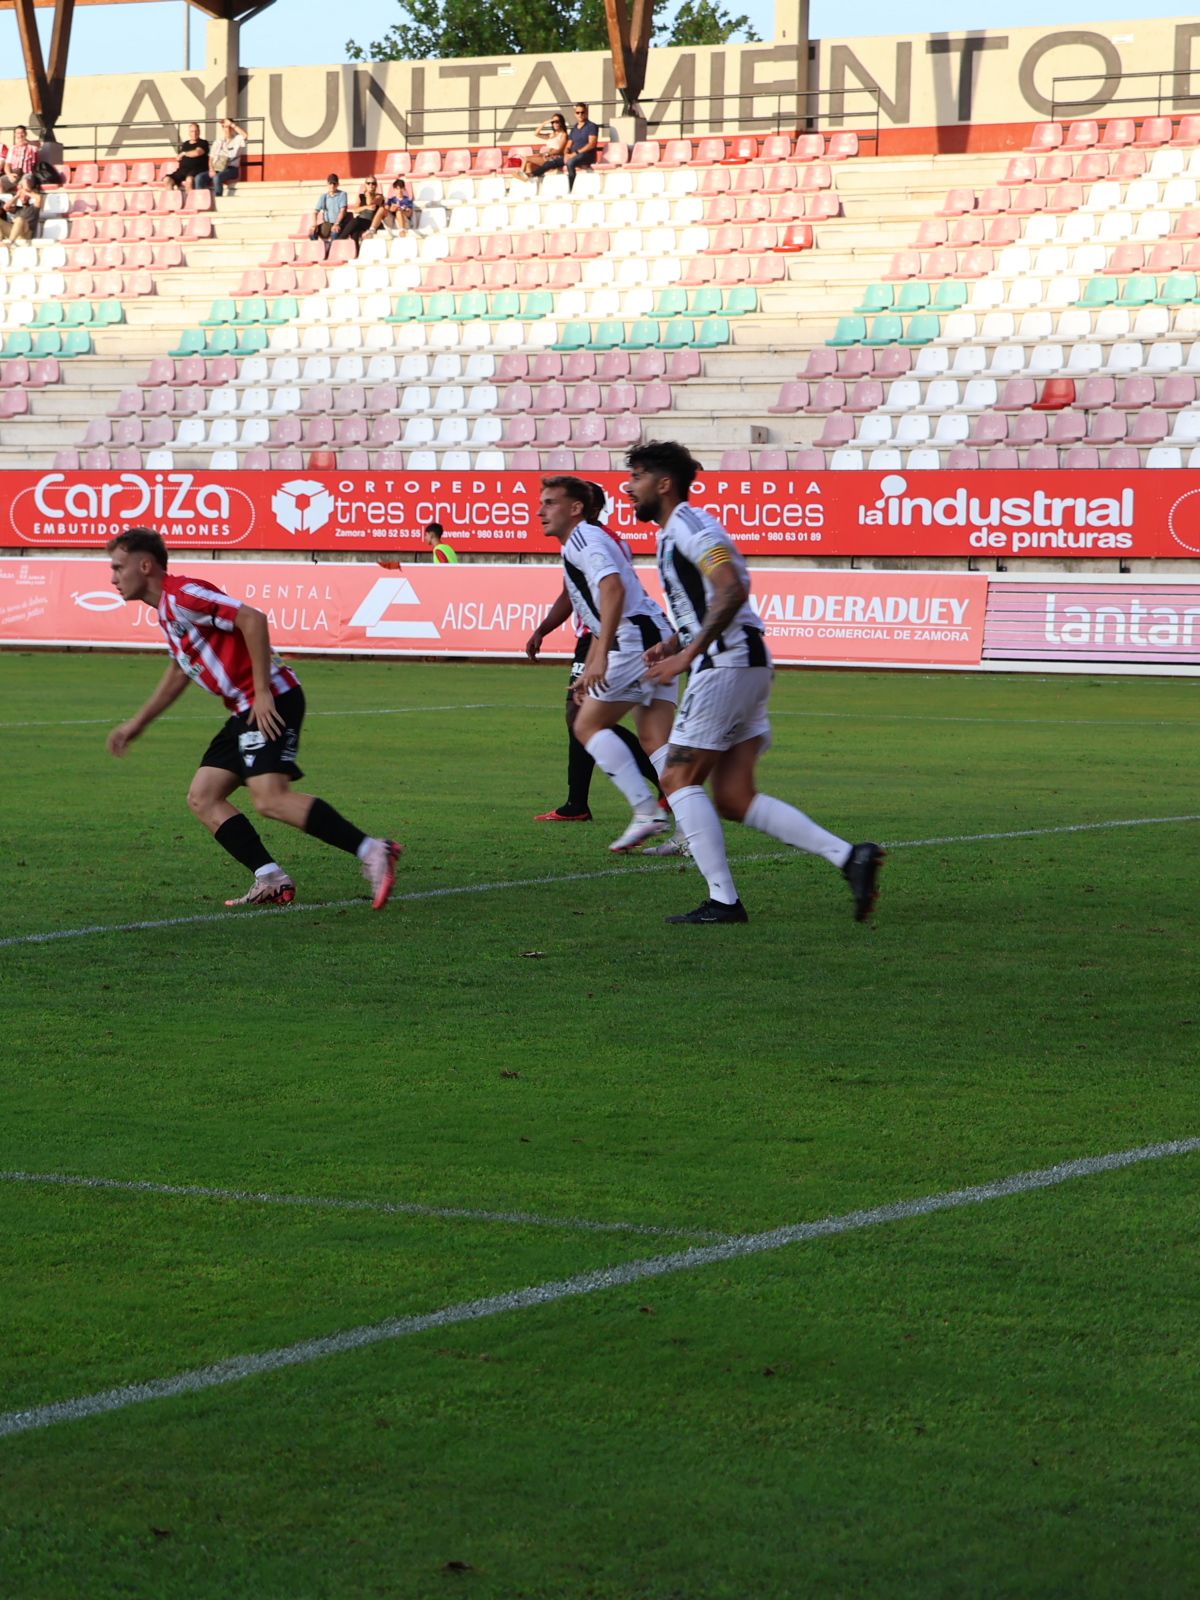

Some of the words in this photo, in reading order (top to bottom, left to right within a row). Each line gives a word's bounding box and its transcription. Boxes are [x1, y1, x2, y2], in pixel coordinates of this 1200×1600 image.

[104, 30, 1123, 157] AYUNTAMIENTO
[338, 481, 527, 494] ORTOPEDIA
[335, 497, 405, 524] tres
[416, 501, 530, 525] cruces
[858, 504, 883, 525] la
[887, 487, 1134, 527] industrial
[33, 522, 130, 535] EMBUTIDOS
[152, 523, 230, 536] JAMONES
[335, 528, 366, 538] Zamora
[372, 529, 387, 538] 980
[388, 529, 398, 538] 52
[400, 529, 410, 538] 53
[411, 529, 421, 538] 55
[477, 530, 492, 539] 980
[494, 530, 504, 539] 63
[505, 530, 515, 539] 01
[517, 530, 527, 539] 89
[768, 532, 783, 541] 980
[785, 532, 795, 541] 63
[798, 532, 808, 541] 01
[810, 532, 822, 541] 89
[969, 526, 1007, 548] de
[1011, 528, 1134, 553] pinturas
[245, 584, 333, 600] DENTAL
[255, 607, 330, 631] AULA
[749, 593, 970, 625] VALDERADUEY
[765, 626, 814, 638] CENTRO
[817, 628, 890, 640] COMERCIAL
[894, 630, 911, 641] DE
[913, 630, 969, 642] ZAMORA
